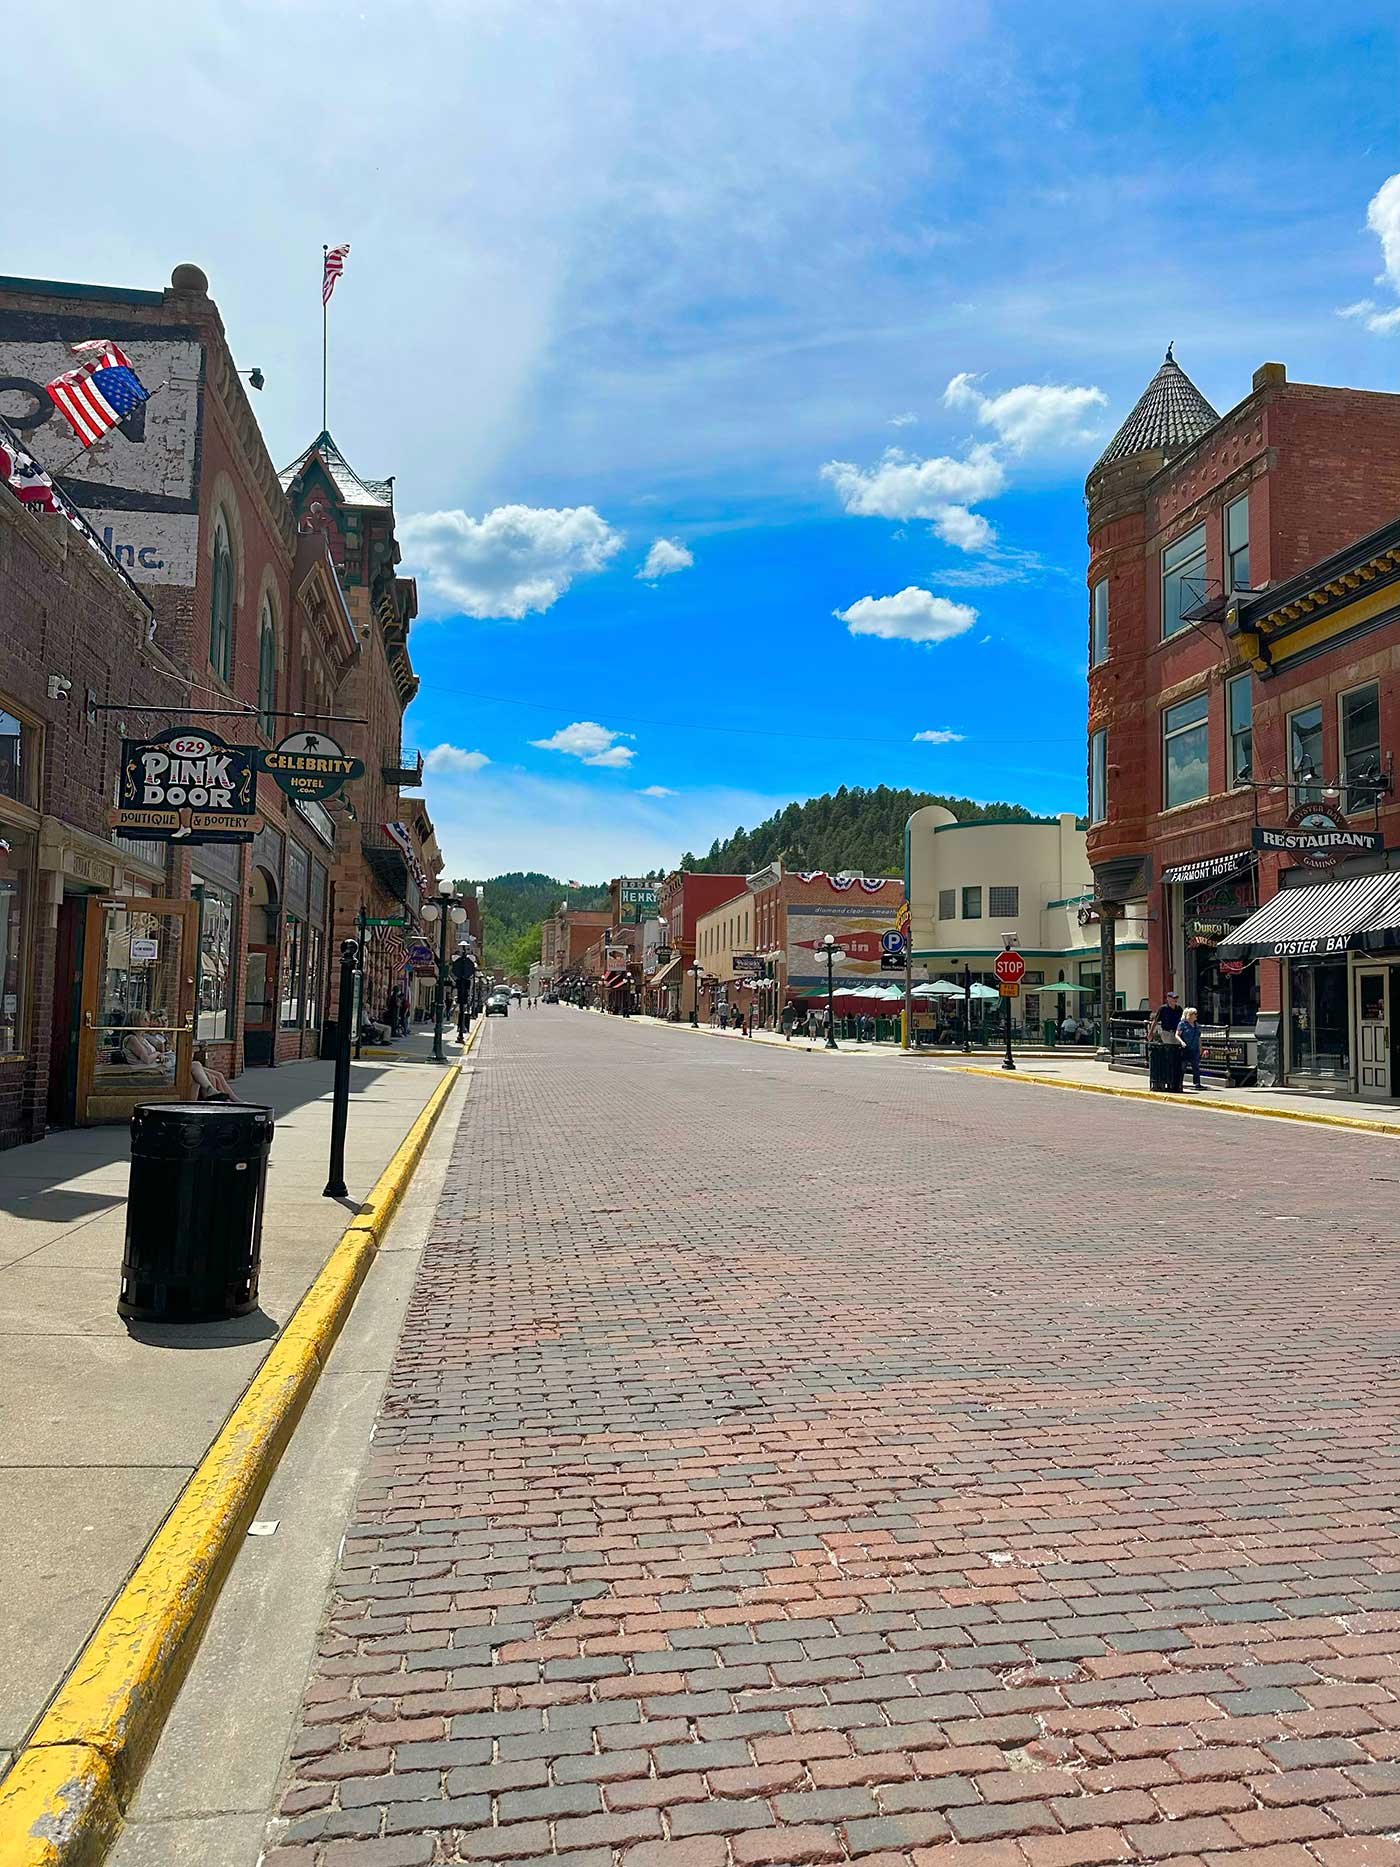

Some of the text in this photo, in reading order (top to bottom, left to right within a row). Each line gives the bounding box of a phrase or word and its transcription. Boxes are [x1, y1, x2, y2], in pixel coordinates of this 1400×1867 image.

[104, 527, 164, 569] Inc.
[175, 741, 205, 752] 629
[141, 752, 236, 789] PINK
[264, 753, 354, 773] CELEBRITY
[290, 777, 325, 788] HOTEL
[142, 786, 233, 808] DOOR
[120, 812, 249, 828] BOUTIQUE & BOOTERY
[1294, 805, 1324, 821] OYSTER
[1262, 831, 1375, 849] RESTAURANT
[1170, 860, 1239, 882] FAIRMONT HOTEL
[1303, 856, 1337, 869] GAMING
[888, 933, 901, 949] P
[1274, 935, 1352, 954] OYSTER BAY
[997, 961, 1023, 973] STOP
